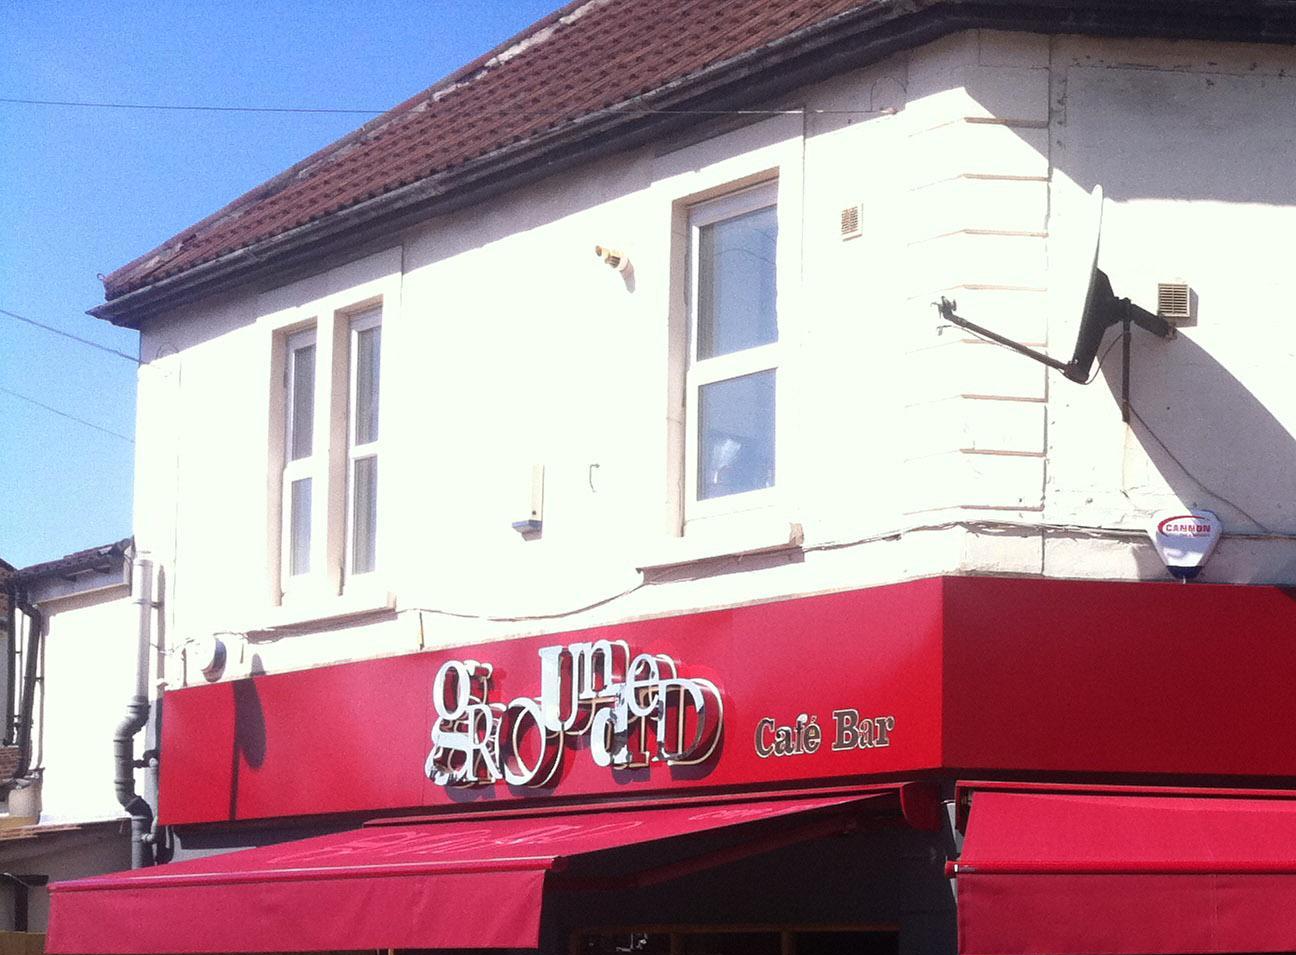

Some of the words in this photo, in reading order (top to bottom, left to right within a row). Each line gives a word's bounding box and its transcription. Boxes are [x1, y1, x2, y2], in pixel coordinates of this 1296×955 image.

[1166, 524, 1211, 532] CANNON
[754, 712, 822, 758] Café
[832, 708, 895, 750] Bar
